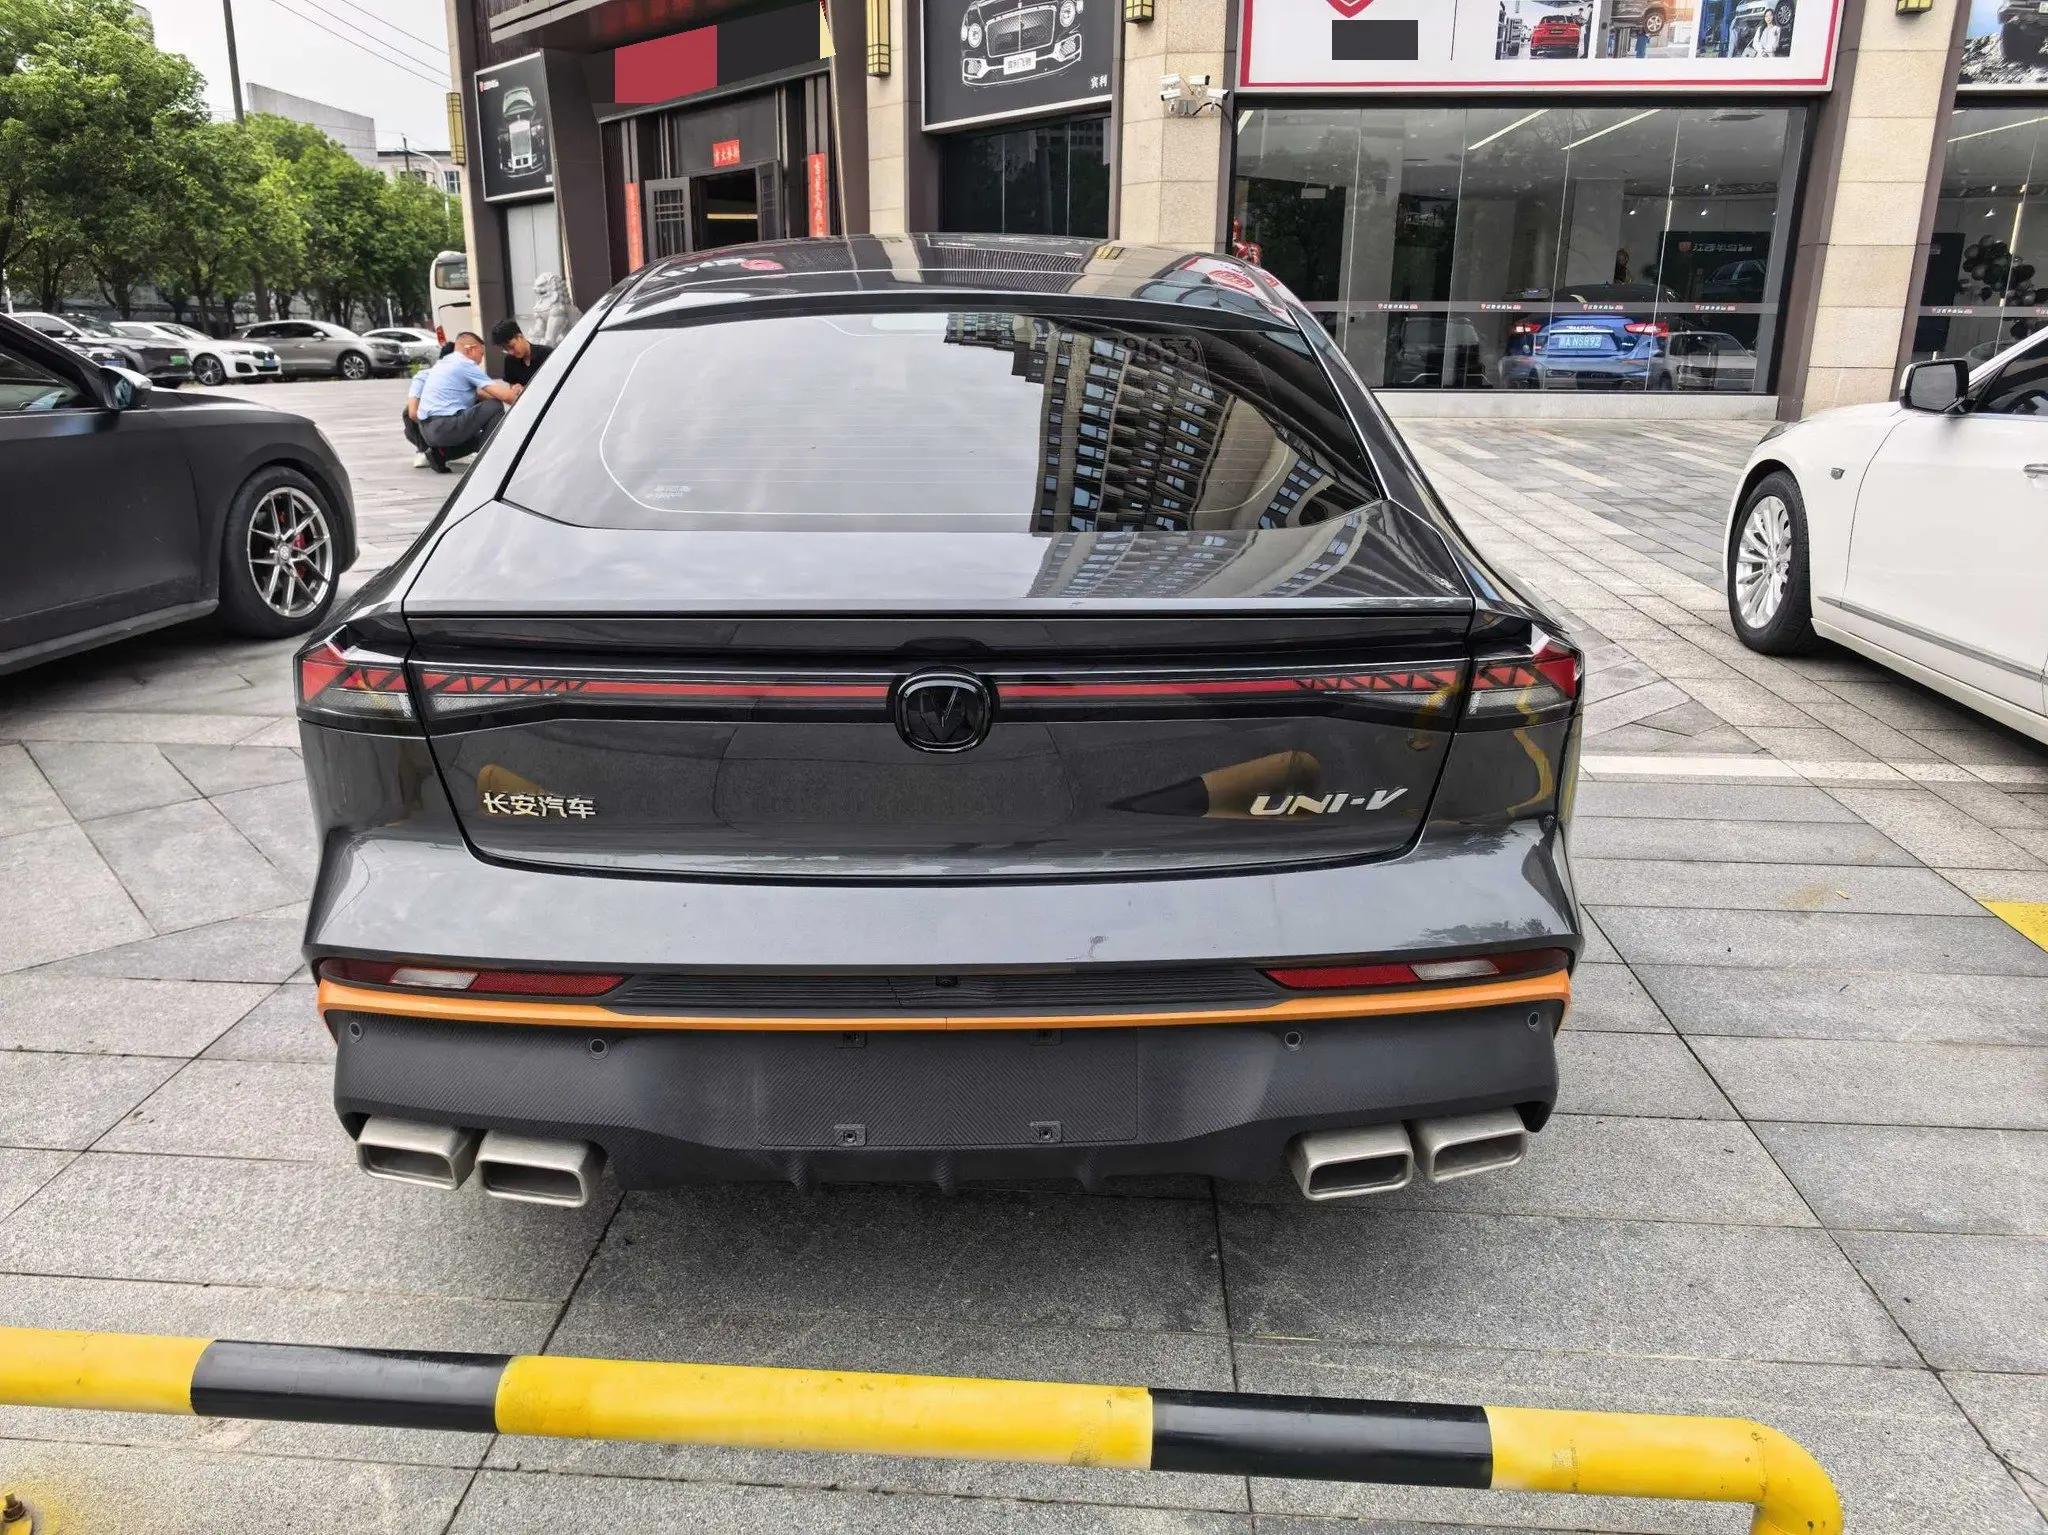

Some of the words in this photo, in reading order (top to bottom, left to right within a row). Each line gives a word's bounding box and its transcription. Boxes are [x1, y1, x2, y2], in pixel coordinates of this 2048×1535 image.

[482, 791, 596, 820] 长安汽车
[1249, 787, 1409, 816] UNI-V
